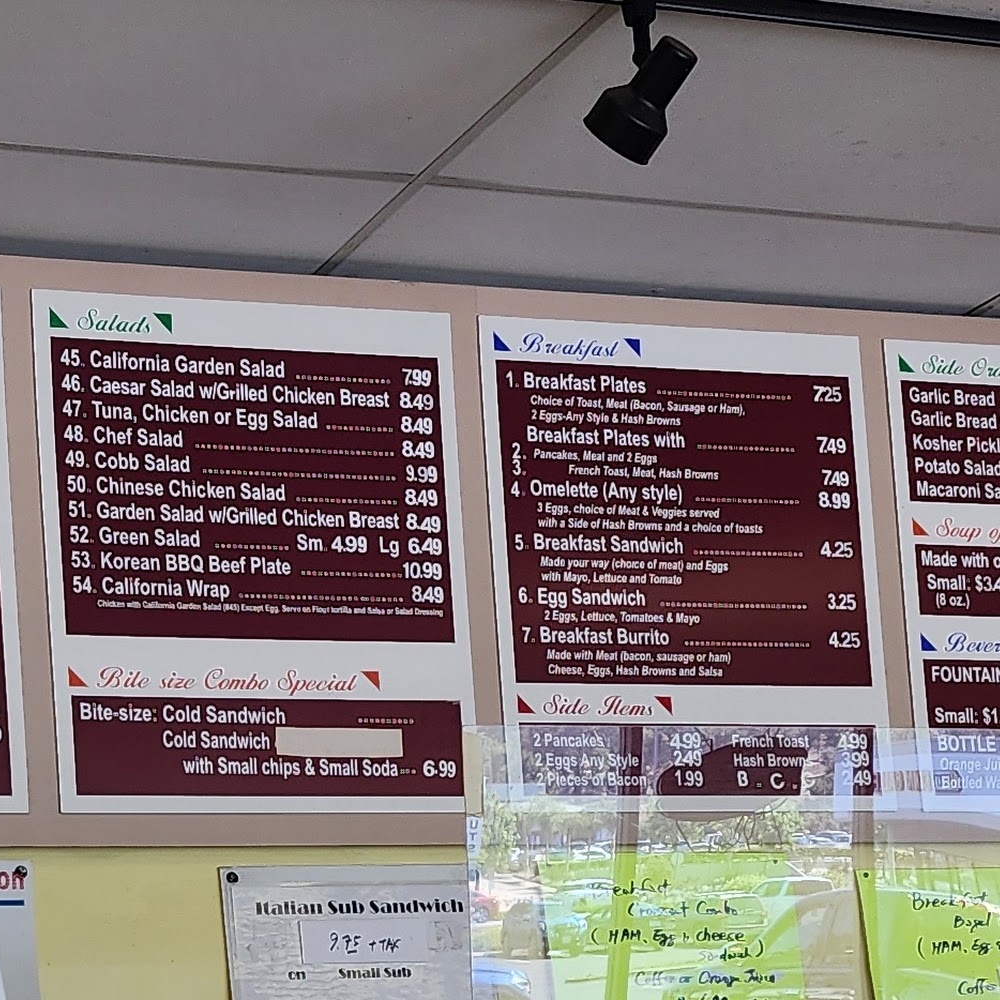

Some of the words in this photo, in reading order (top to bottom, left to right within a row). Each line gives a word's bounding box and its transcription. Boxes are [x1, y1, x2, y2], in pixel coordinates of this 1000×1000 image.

[77, 308, 152, 334] Salads
[519, 333, 619, 361] Breakfast
[61, 349, 85, 367] 45.
[90, 350, 170, 372] California
[175, 355, 234, 375] Garden
[240, 359, 284, 378] Salad
[402, 369, 431, 386] 7.99
[922, 354, 964, 376] Side
[506, 371, 519, 387] 1.
[524, 372, 596, 391] Breakfast
[600, 376, 646, 393] Plates
[813, 386, 842, 402] 7.25
[910, 387, 950, 404] Garlic
[954, 390, 995, 406] Bread
[532, 409, 537, 420] 2
[539, 410, 584, 424] Eggs-Any
[586, 412, 609, 425] Style
[612, 413, 618, 423] &
[621, 413, 644, 424] Hash
[646, 414, 680, 425] Browns
[71, 551, 95, 568] 53.
[101, 551, 160, 570] Korean
[166, 554, 204, 573] BBQ
[209, 556, 246, 573] Beef
[250, 557, 291, 575] Plate
[403, 562, 442, 580] 10.99
[927, 574, 970, 590] Small:
[936, 593, 946, 608] (8
[949, 593, 969, 609] oz.)
[97, 667, 150, 689] Bite
[159, 671, 196, 689] size
[203, 668, 269, 691] Combo
[277, 670, 358, 696] Special
[543, 694, 590, 717] Side
[598, 695, 654, 717] Items
[533, 733, 541, 748] 2
[542, 733, 606, 749] Pancakes
[731, 733, 773, 750] French
[776, 733, 810, 750] Toast
[938, 735, 996, 752] BOTTLE
[183, 756, 213, 774] with
[218, 757, 257, 774] Small
[262, 758, 300, 779] chips
[305, 758, 315, 775] &
[320, 759, 358, 775] Small
[363, 759, 398, 776] Soda
[423, 760, 456, 777] 6.99
[256, 901, 322, 915] Italian
[328, 899, 364, 914] Sub
[369, 898, 463, 913] Sandwich
[696, 927, 746, 942] cheese
[288, 971, 306, 979] on
[339, 967, 380, 979] Small
[384, 966, 411, 978] Sub
